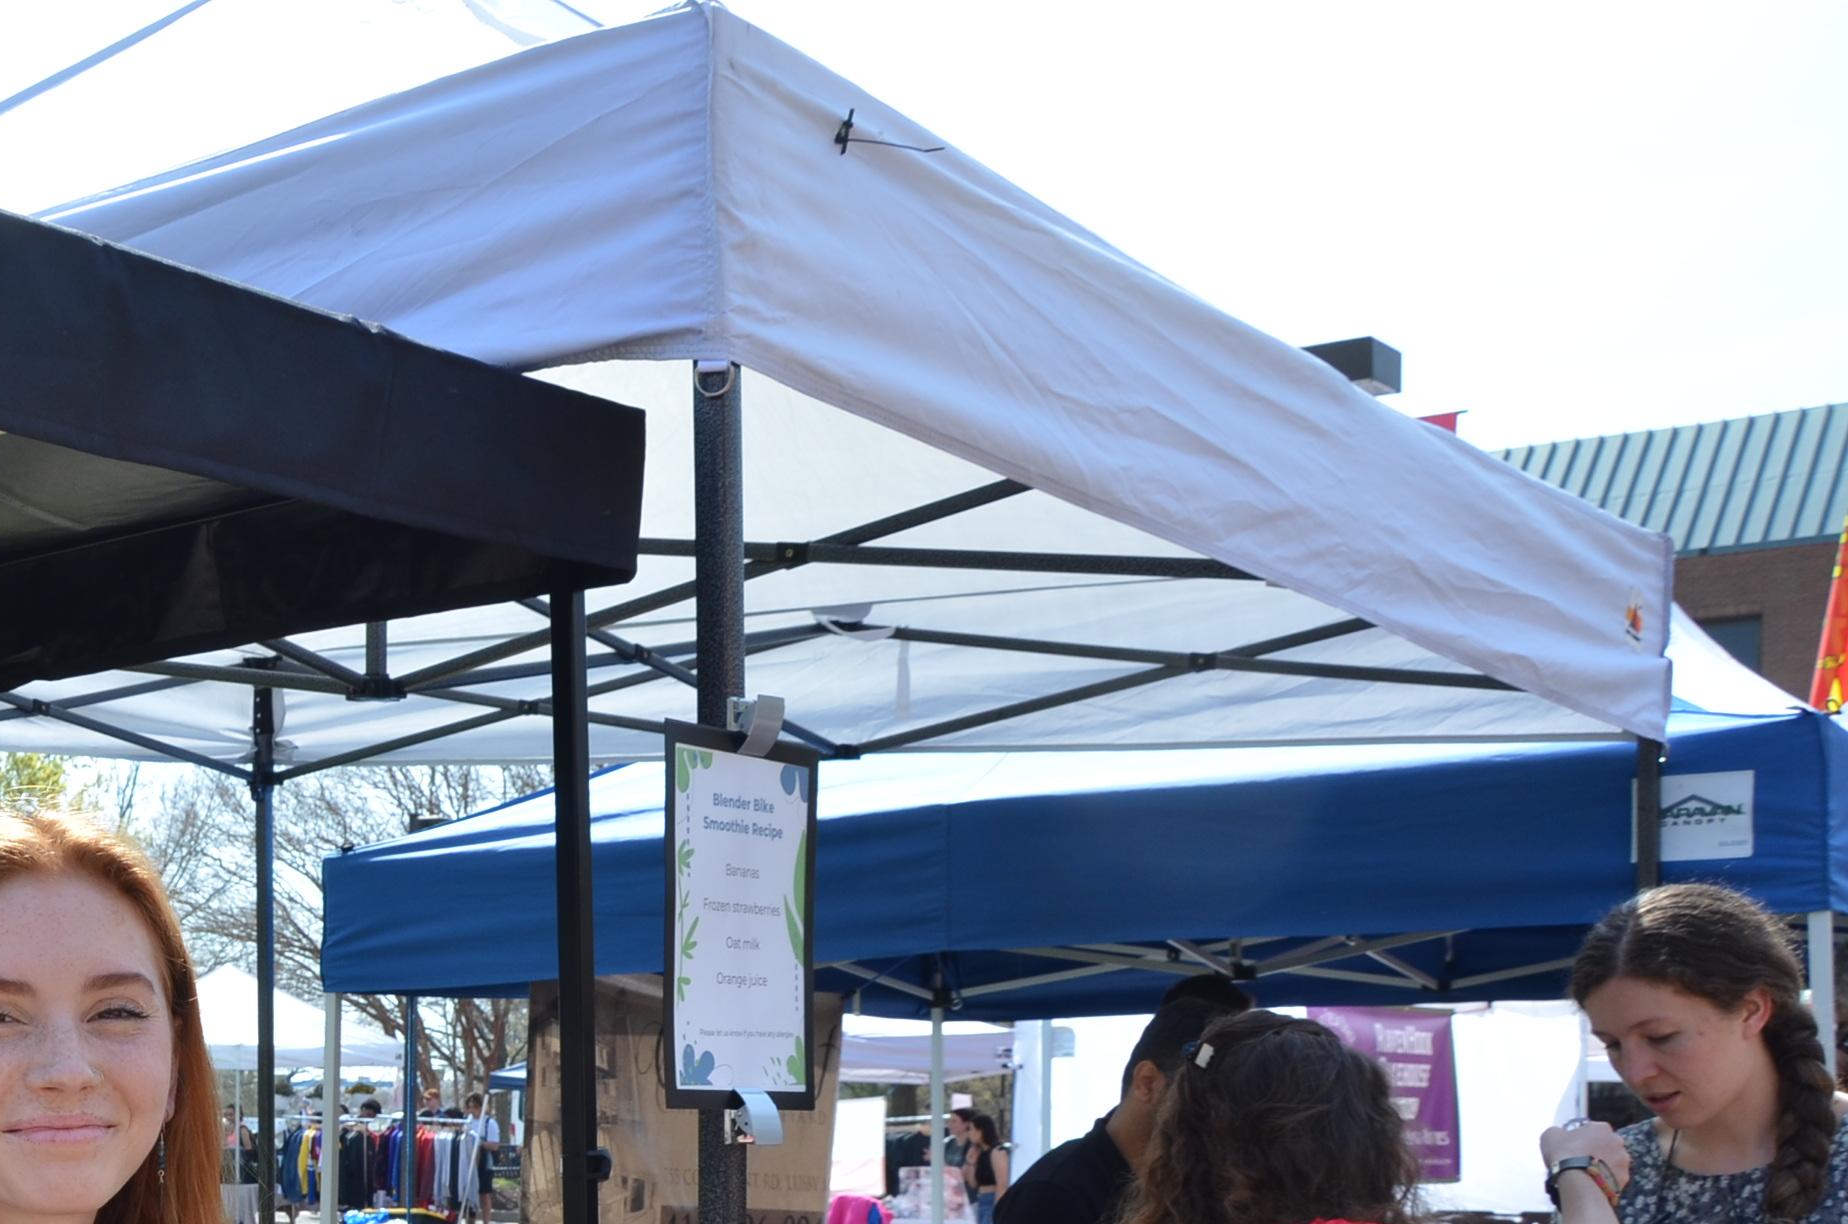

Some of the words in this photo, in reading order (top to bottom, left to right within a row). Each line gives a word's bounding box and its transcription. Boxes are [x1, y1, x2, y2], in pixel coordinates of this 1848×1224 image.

[712, 792, 751, 811] Blender
[752, 798, 775, 814] Bike
[1660, 804, 1746, 820] ARAVAN
[703, 816, 750, 835] Smoothie
[752, 823, 783, 841] Recipe
[725, 863, 760, 880] Bananas
[703, 897, 731, 913] Frozen
[732, 902, 781, 917] strawberries
[725, 936, 741, 950] Oat
[742, 938, 760, 951] milk
[716, 972, 748, 989] Orange
[748, 974, 769, 989] juice
